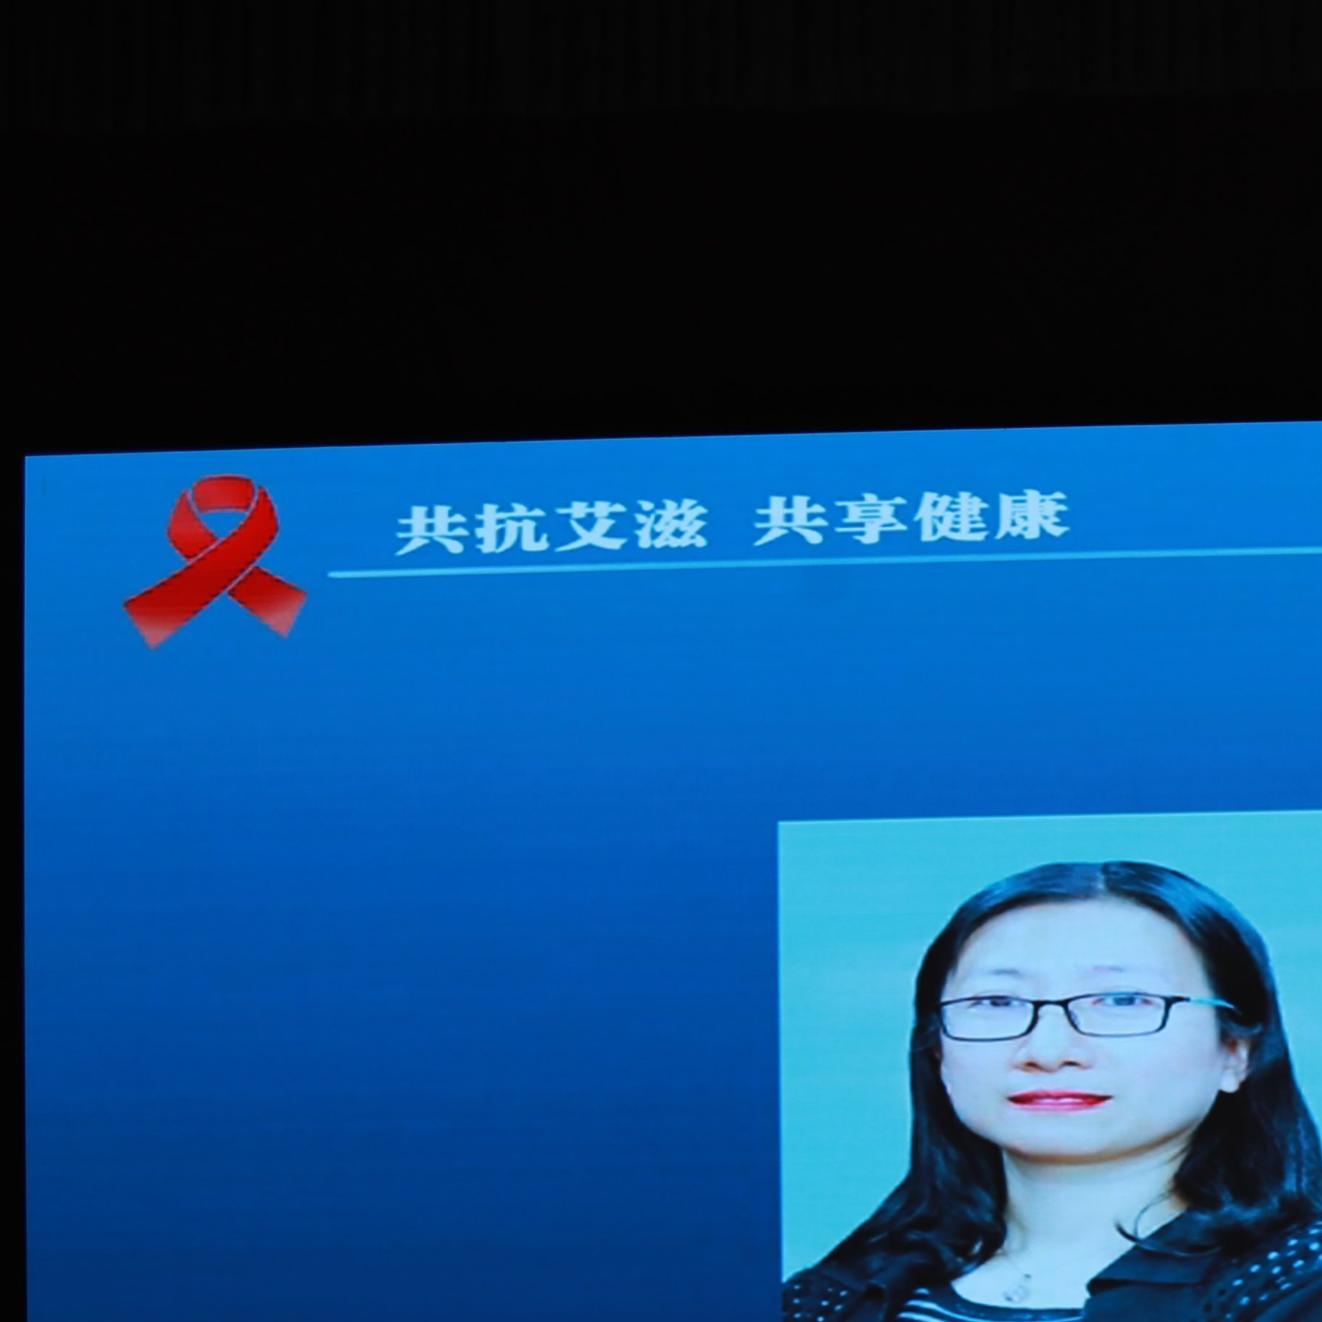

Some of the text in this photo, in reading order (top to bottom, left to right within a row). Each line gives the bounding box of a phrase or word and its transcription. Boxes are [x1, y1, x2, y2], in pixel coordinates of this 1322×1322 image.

[396, 488, 1070, 556] 共抗艾滋 共享健康
